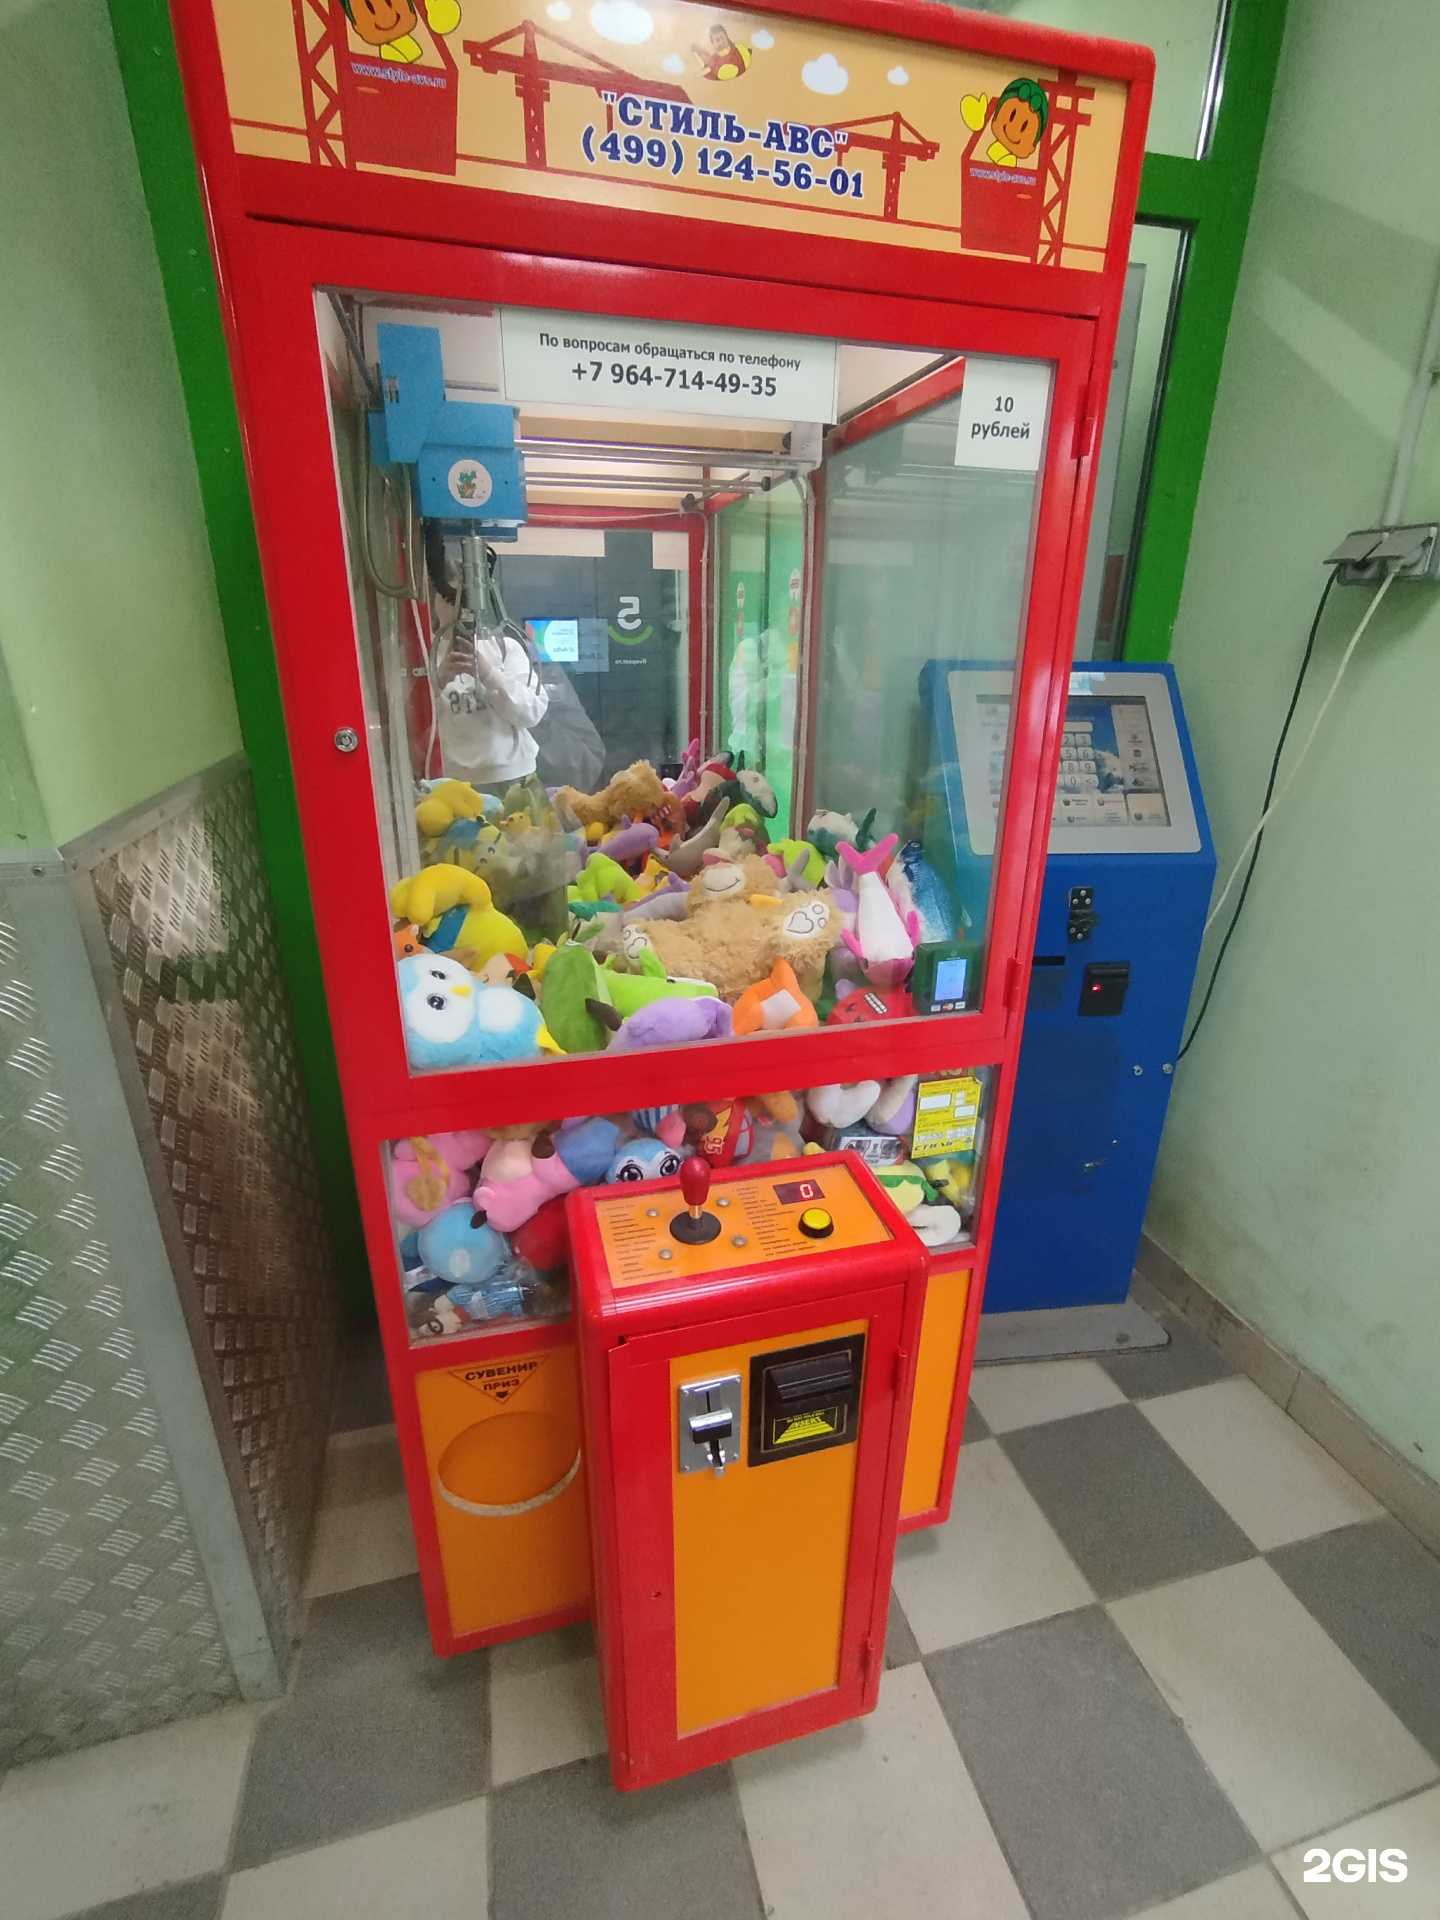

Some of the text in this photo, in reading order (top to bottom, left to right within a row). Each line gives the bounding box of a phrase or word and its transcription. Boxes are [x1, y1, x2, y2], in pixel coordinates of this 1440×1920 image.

[602, 92, 848, 159] "СТИЛЬ-АВС"
[582, 126, 864, 198] (499) 124-56-01
[539, 333, 801, 371] По вопросам обращаться по телефону
[571, 361, 778, 397] +7 964-714-49-35
[994, 395, 1014, 413] 10
[971, 421, 1030, 440] рублей
[800, 1183, 814, 1199] 0
[464, 1361, 538, 1381] СУВЕНИР
[483, 1378, 520, 1391] ПРИЗ
